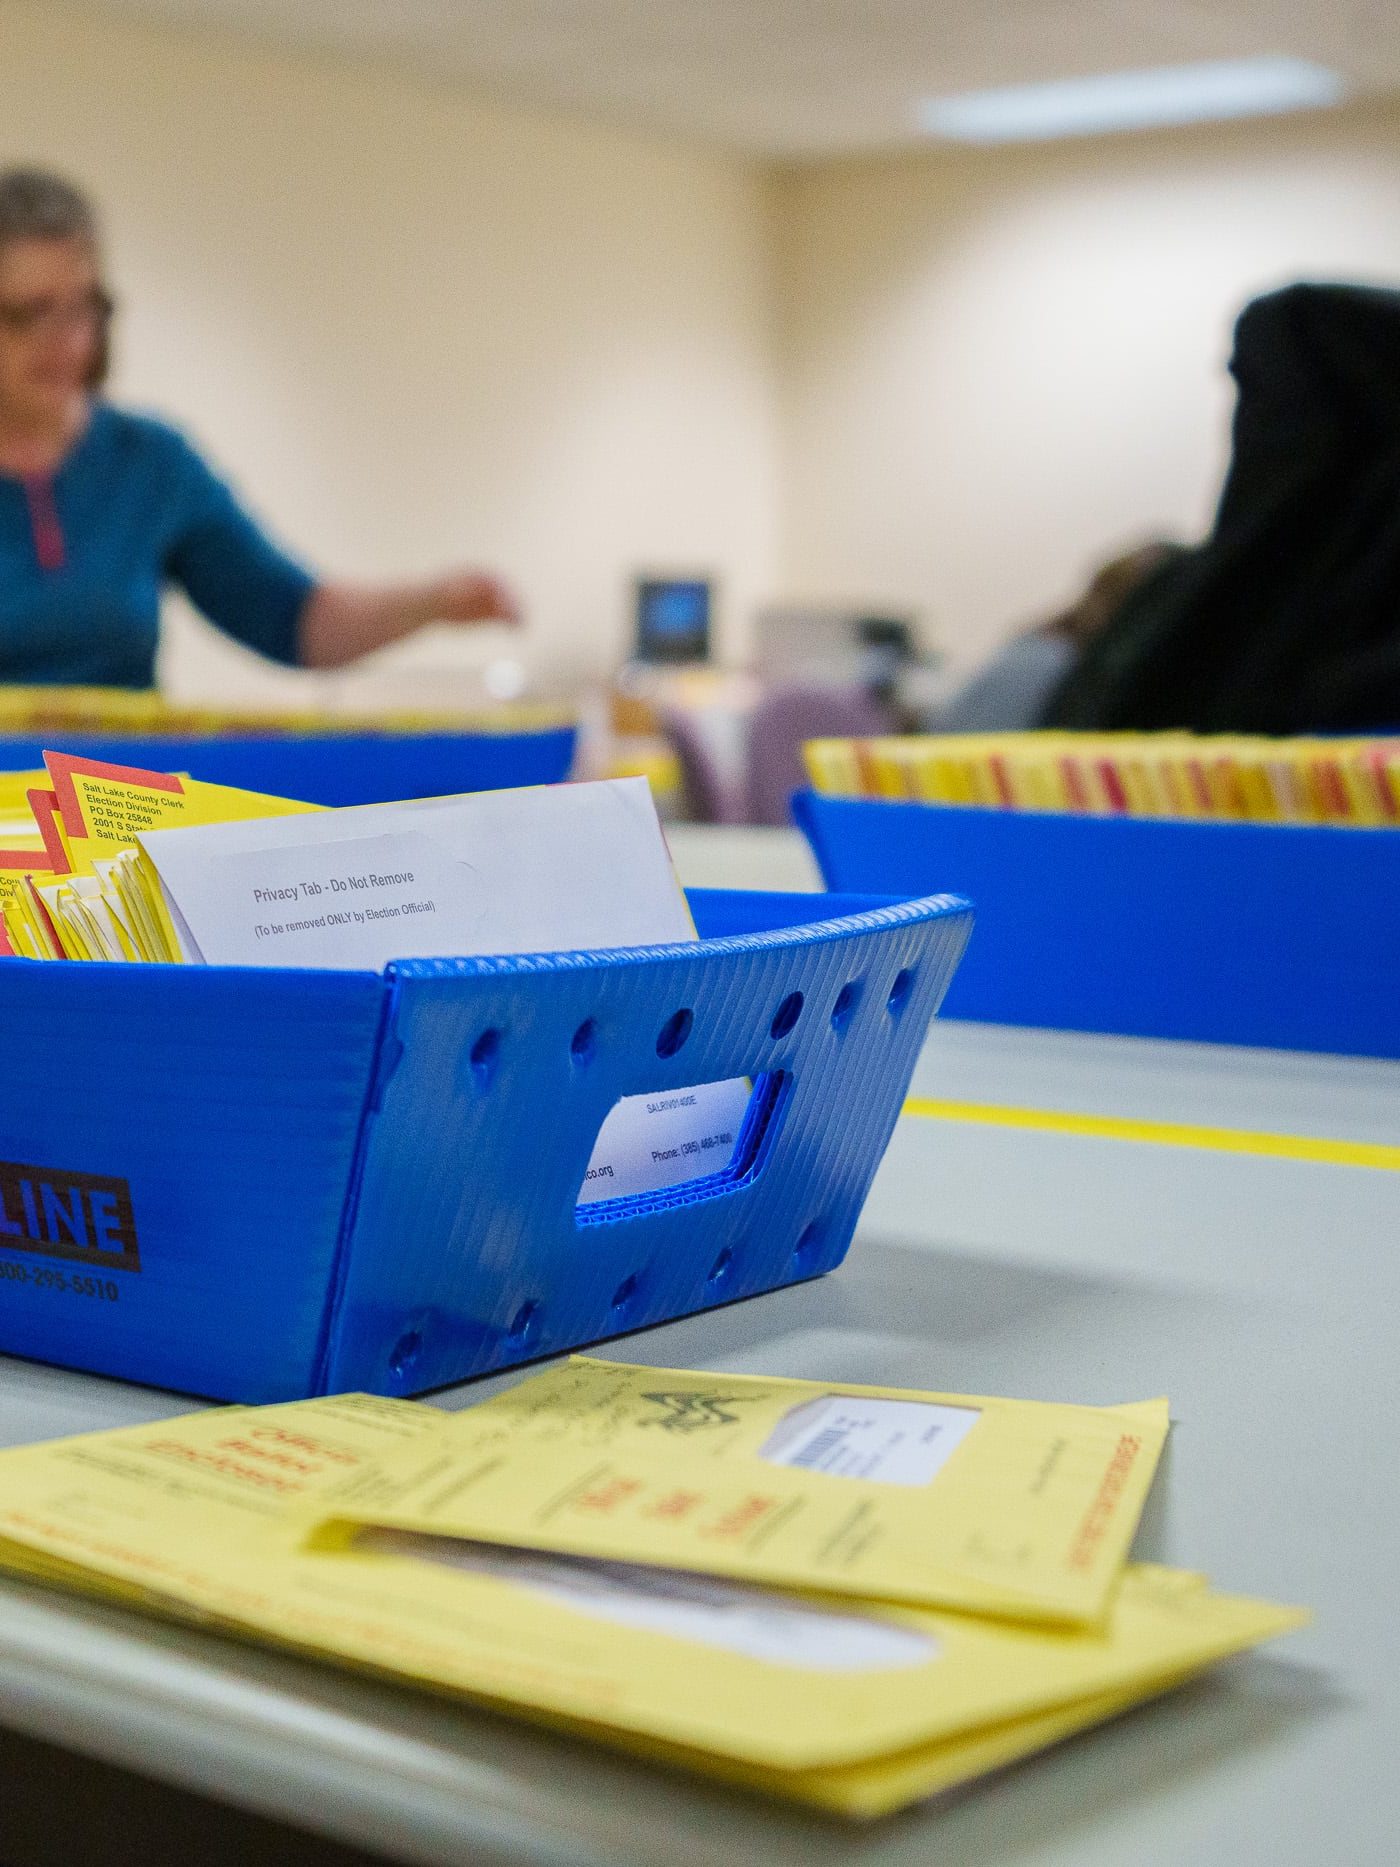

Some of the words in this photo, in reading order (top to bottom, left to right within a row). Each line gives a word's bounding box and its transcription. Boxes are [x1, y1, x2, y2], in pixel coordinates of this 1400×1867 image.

[83, 783, 101, 793] Salt
[103, 787, 125, 798] Lake
[127, 791, 159, 806] County
[160, 798, 184, 809] Clerk
[86, 794, 123, 808] Election
[126, 801, 162, 815] Division
[89, 806, 104, 815] PO
[106, 808, 124, 819] Box
[126, 813, 153, 825] 25848
[93, 817, 114, 828] 2001
[117, 821, 124, 831] S
[96, 829, 115, 841] Salt
[254, 884, 298, 903] Privacy
[299, 882, 322, 898] Tab
[330, 878, 347, 893] Do
[349, 876, 368, 891] Not
[369, 871, 414, 887] Remove
[254, 925, 270, 940] (To
[271, 922, 284, 934] be
[285, 917, 326, 933] removed
[326, 912, 352, 926] ONLY
[353, 911, 364, 924] by
[365, 906, 400, 921] Election
[401, 900, 435, 916] Official)
[651, 1148, 681, 1162] Phone:
[681, 1141, 701, 1158] (385)
